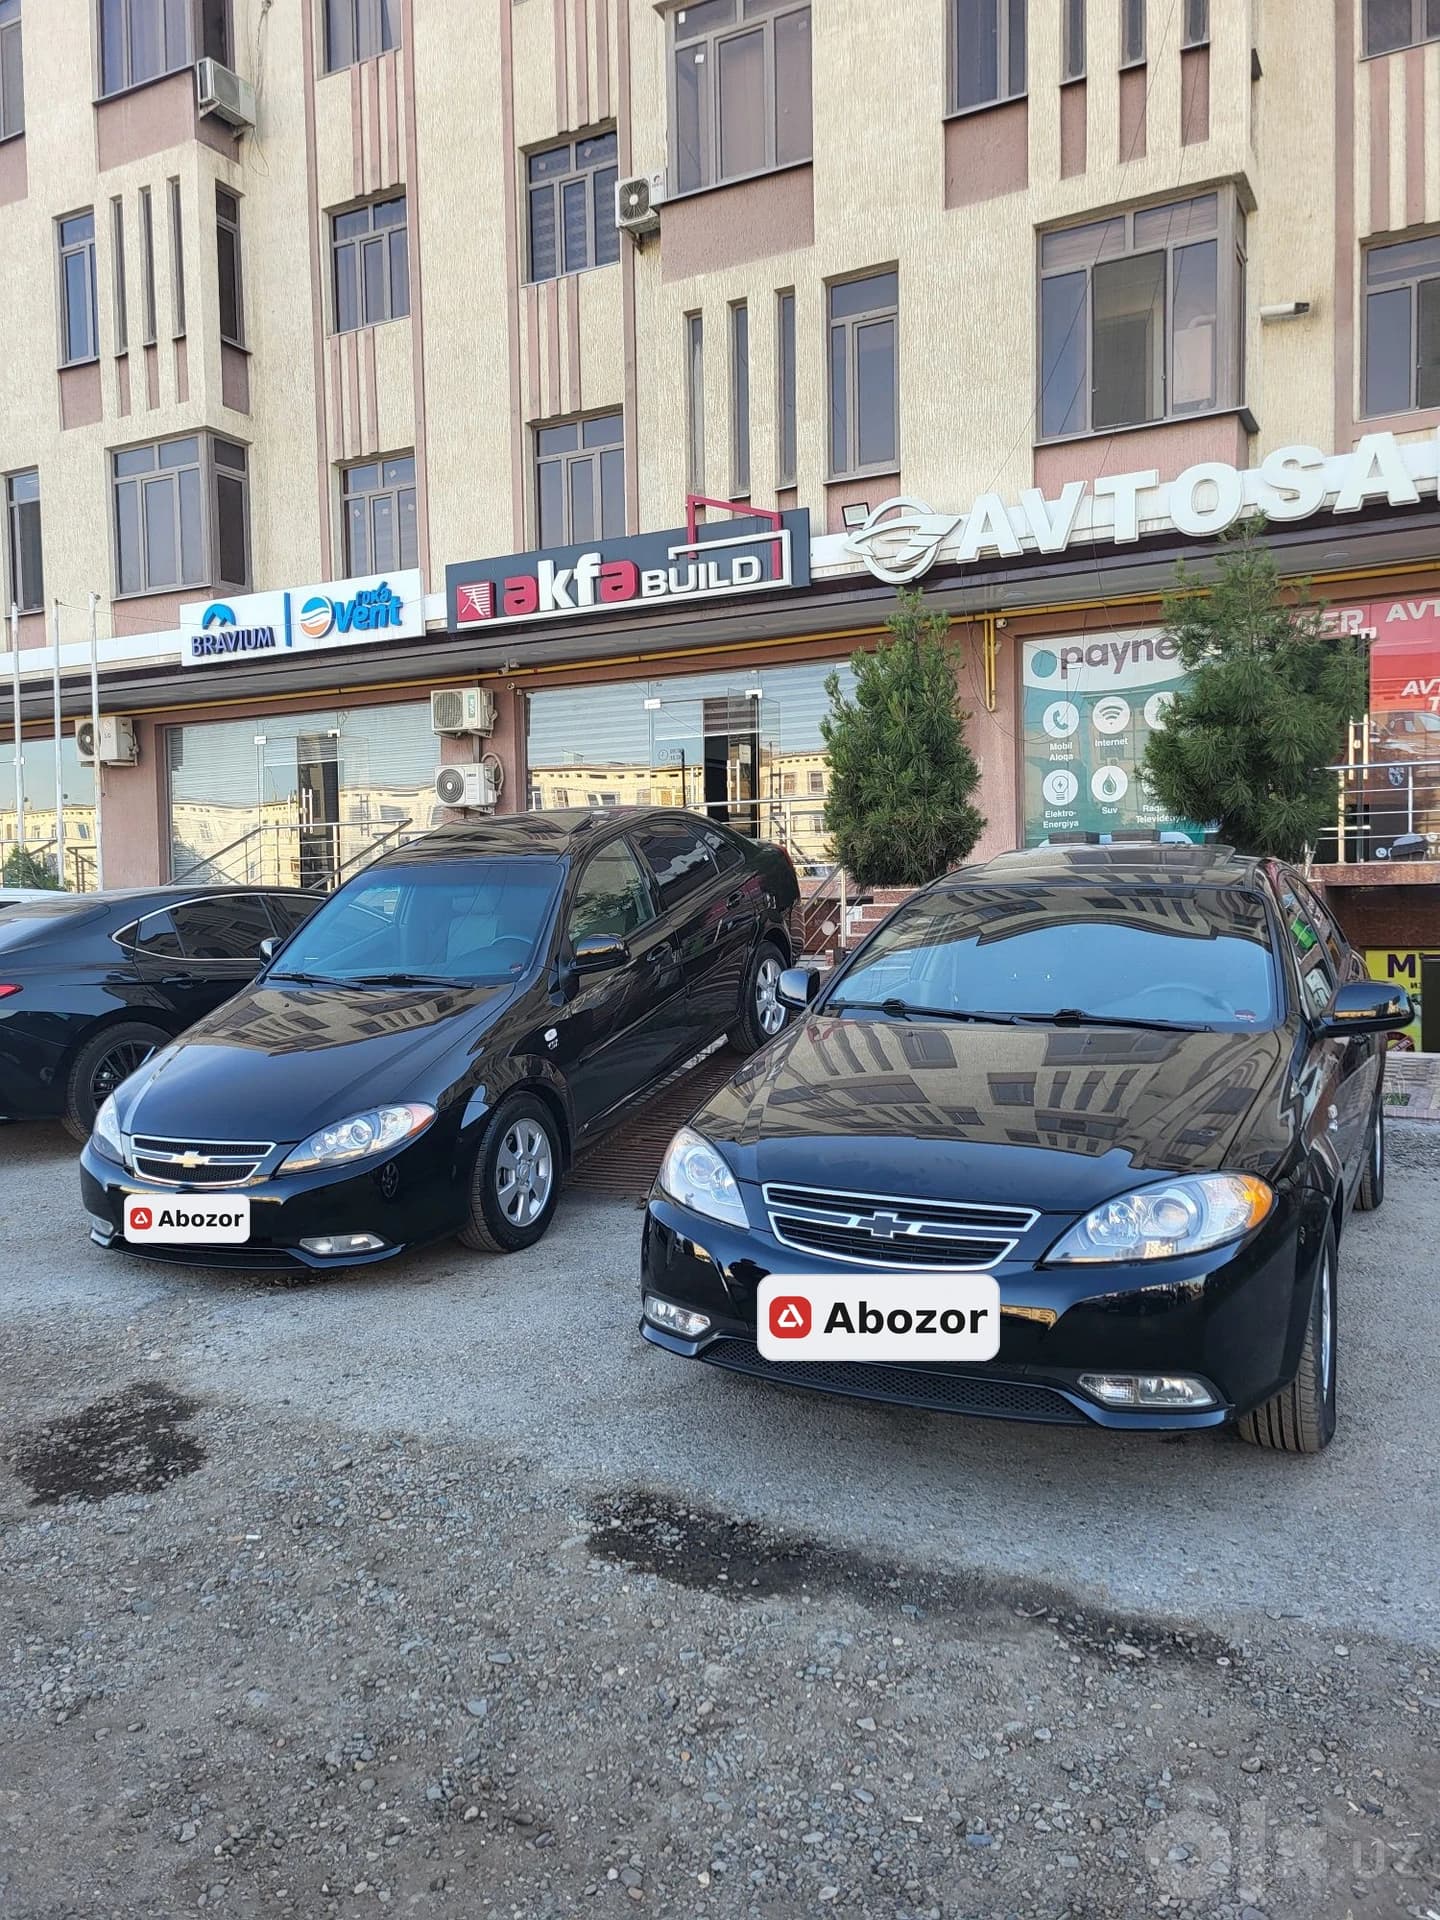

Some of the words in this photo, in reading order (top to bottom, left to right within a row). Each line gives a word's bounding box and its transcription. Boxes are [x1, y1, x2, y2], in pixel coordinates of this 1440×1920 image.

[956, 431, 1440, 564] AVTOSA
[503, 552, 639, 616] akfa
[642, 554, 763, 598] BUILD
[334, 595, 403, 634] Vent
[191, 626, 276, 656] BRAVIUM
[1060, 635, 1180, 680] payne
[1049, 742, 1073, 751] Mobil
[1094, 737, 1129, 748] Internet
[1049, 753, 1074, 762] Aloqa
[1101, 807, 1118, 815] Suv
[1043, 819, 1079, 829] Energiya
